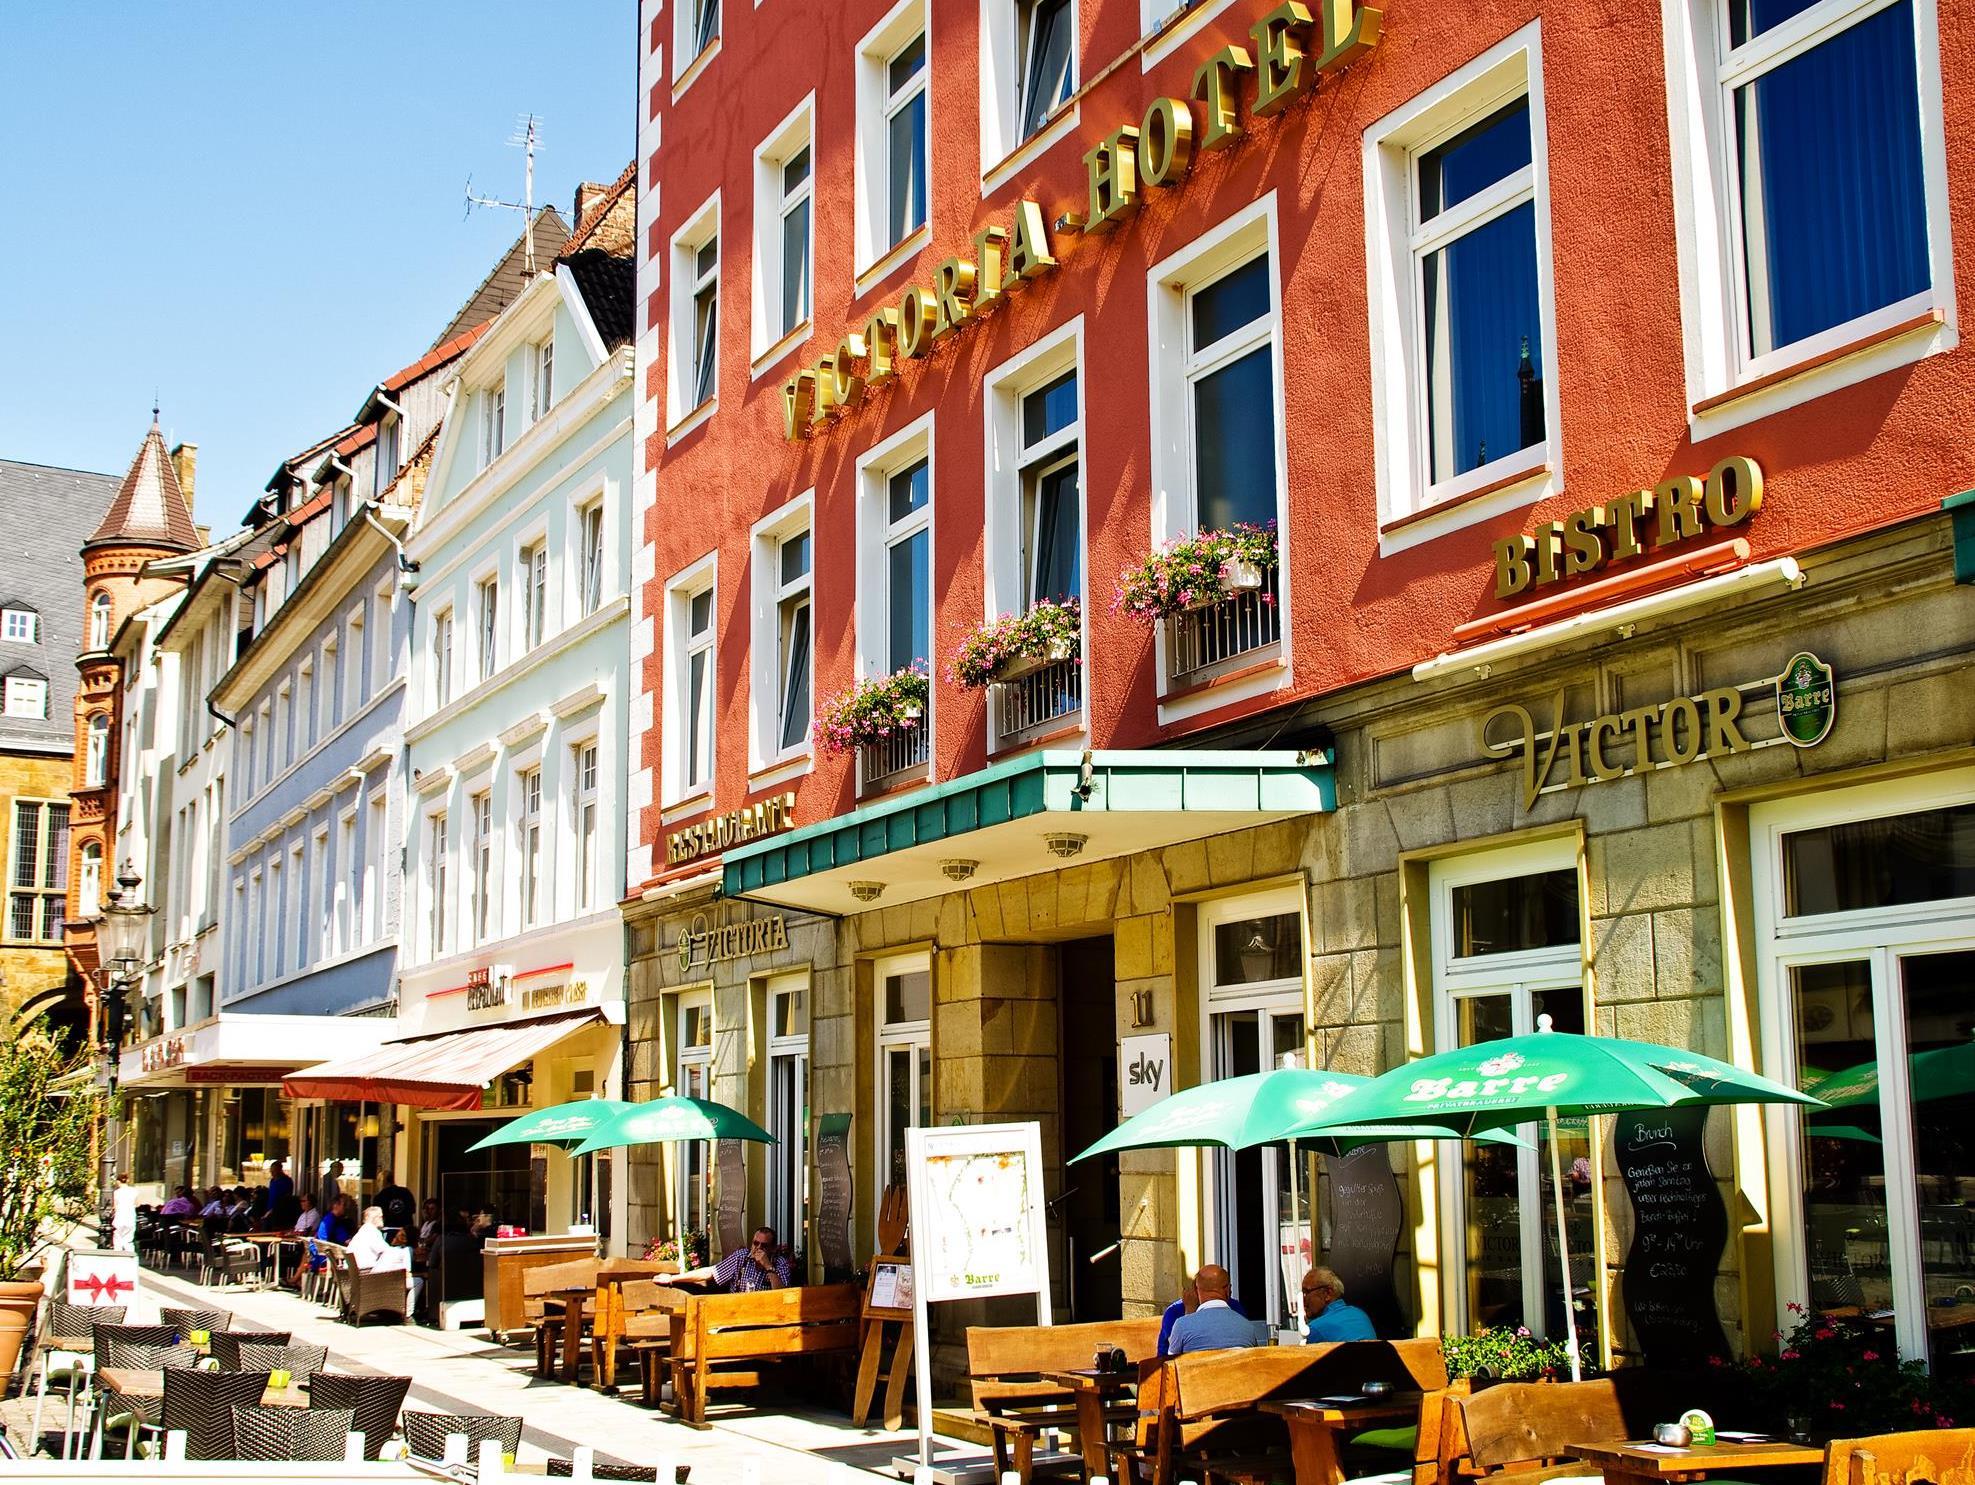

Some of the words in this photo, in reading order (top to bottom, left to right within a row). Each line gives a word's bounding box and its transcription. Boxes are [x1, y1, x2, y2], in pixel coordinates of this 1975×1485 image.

[1491, 455, 1765, 600] BISTRO
[1781, 688, 1830, 712] Barre
[1480, 687, 1751, 812] VICTOR
[665, 791, 796, 866] RESTAURANT
[691, 904, 790, 971] VICTORIA
[1130, 990, 1154, 1029] 11
[1129, 1051, 1163, 1092] sky
[1403, 1073, 1568, 1102] Barre
[1634, 1120, 1673, 1143] Brunch
[964, 1272, 1000, 1286] Barre
